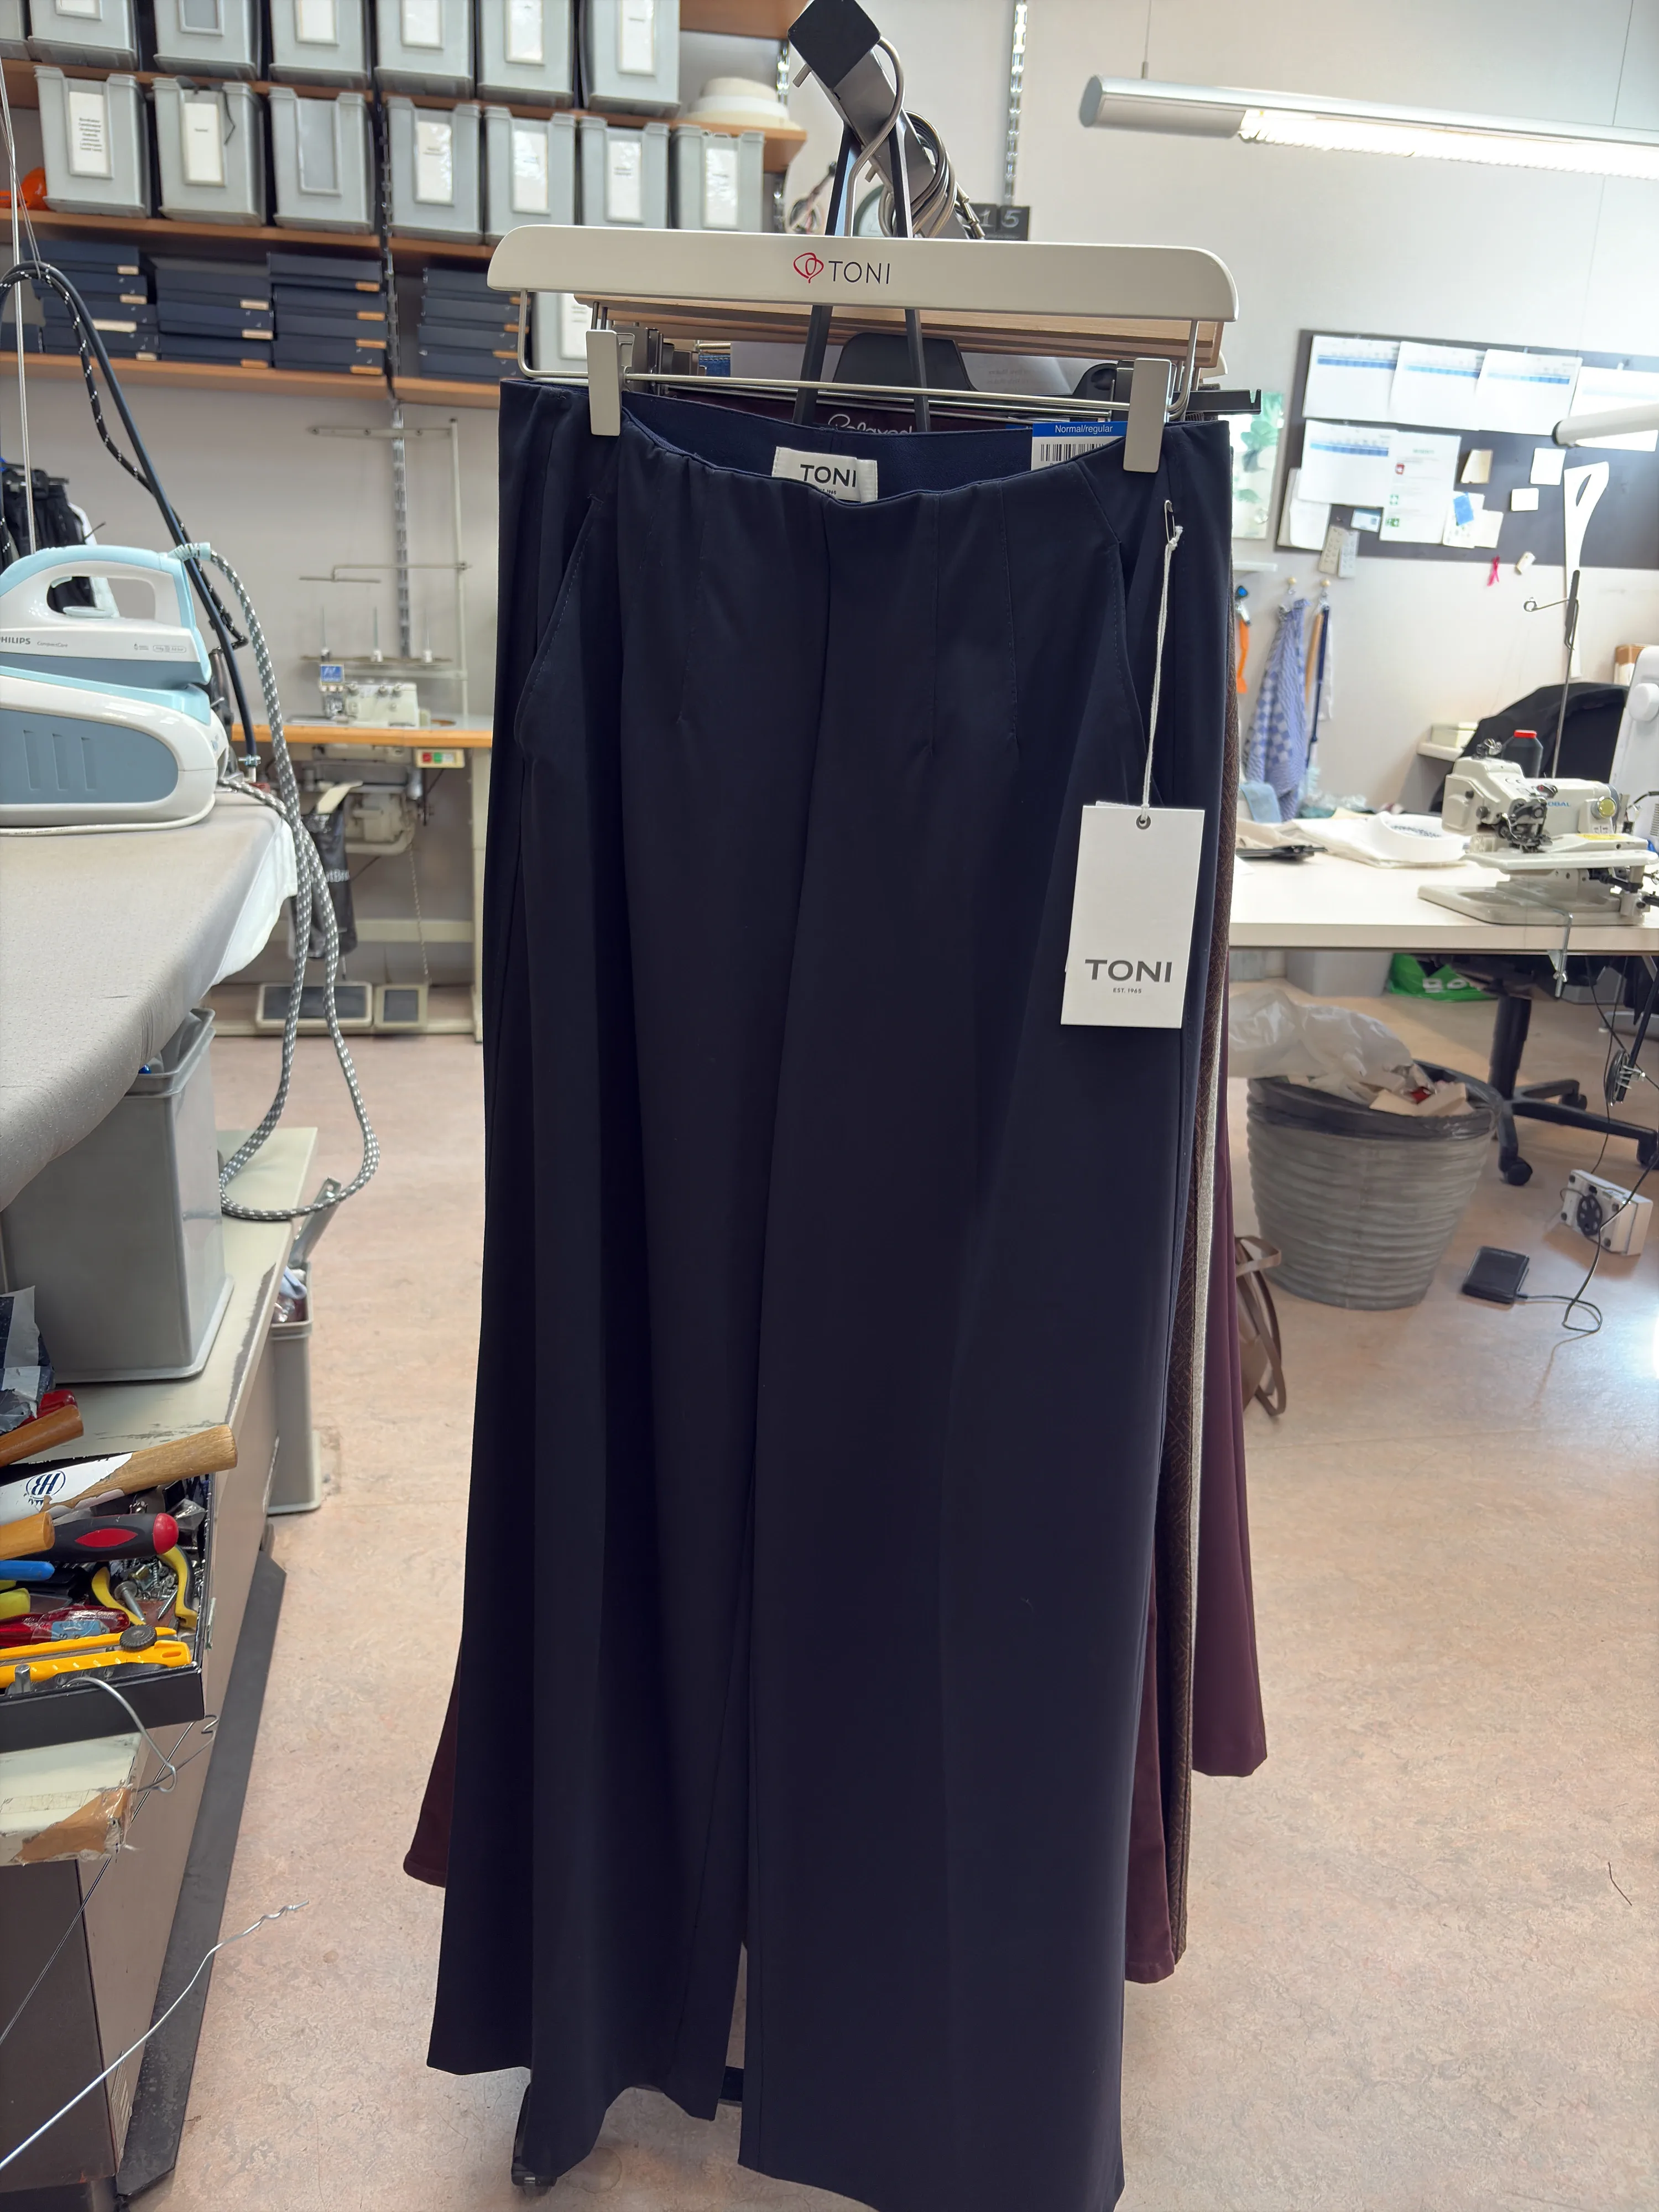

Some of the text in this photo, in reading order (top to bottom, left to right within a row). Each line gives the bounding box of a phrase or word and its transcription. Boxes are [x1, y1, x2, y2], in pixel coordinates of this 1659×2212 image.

[978, 208, 1022, 228] 15
[828, 260, 890, 284] TONI
[1055, 425, 1113, 435] Normal/regular
[800, 464, 857, 487] TONI
[0, 636, 30, 645] HILIPS
[1085, 959, 1172, 983] TONI
